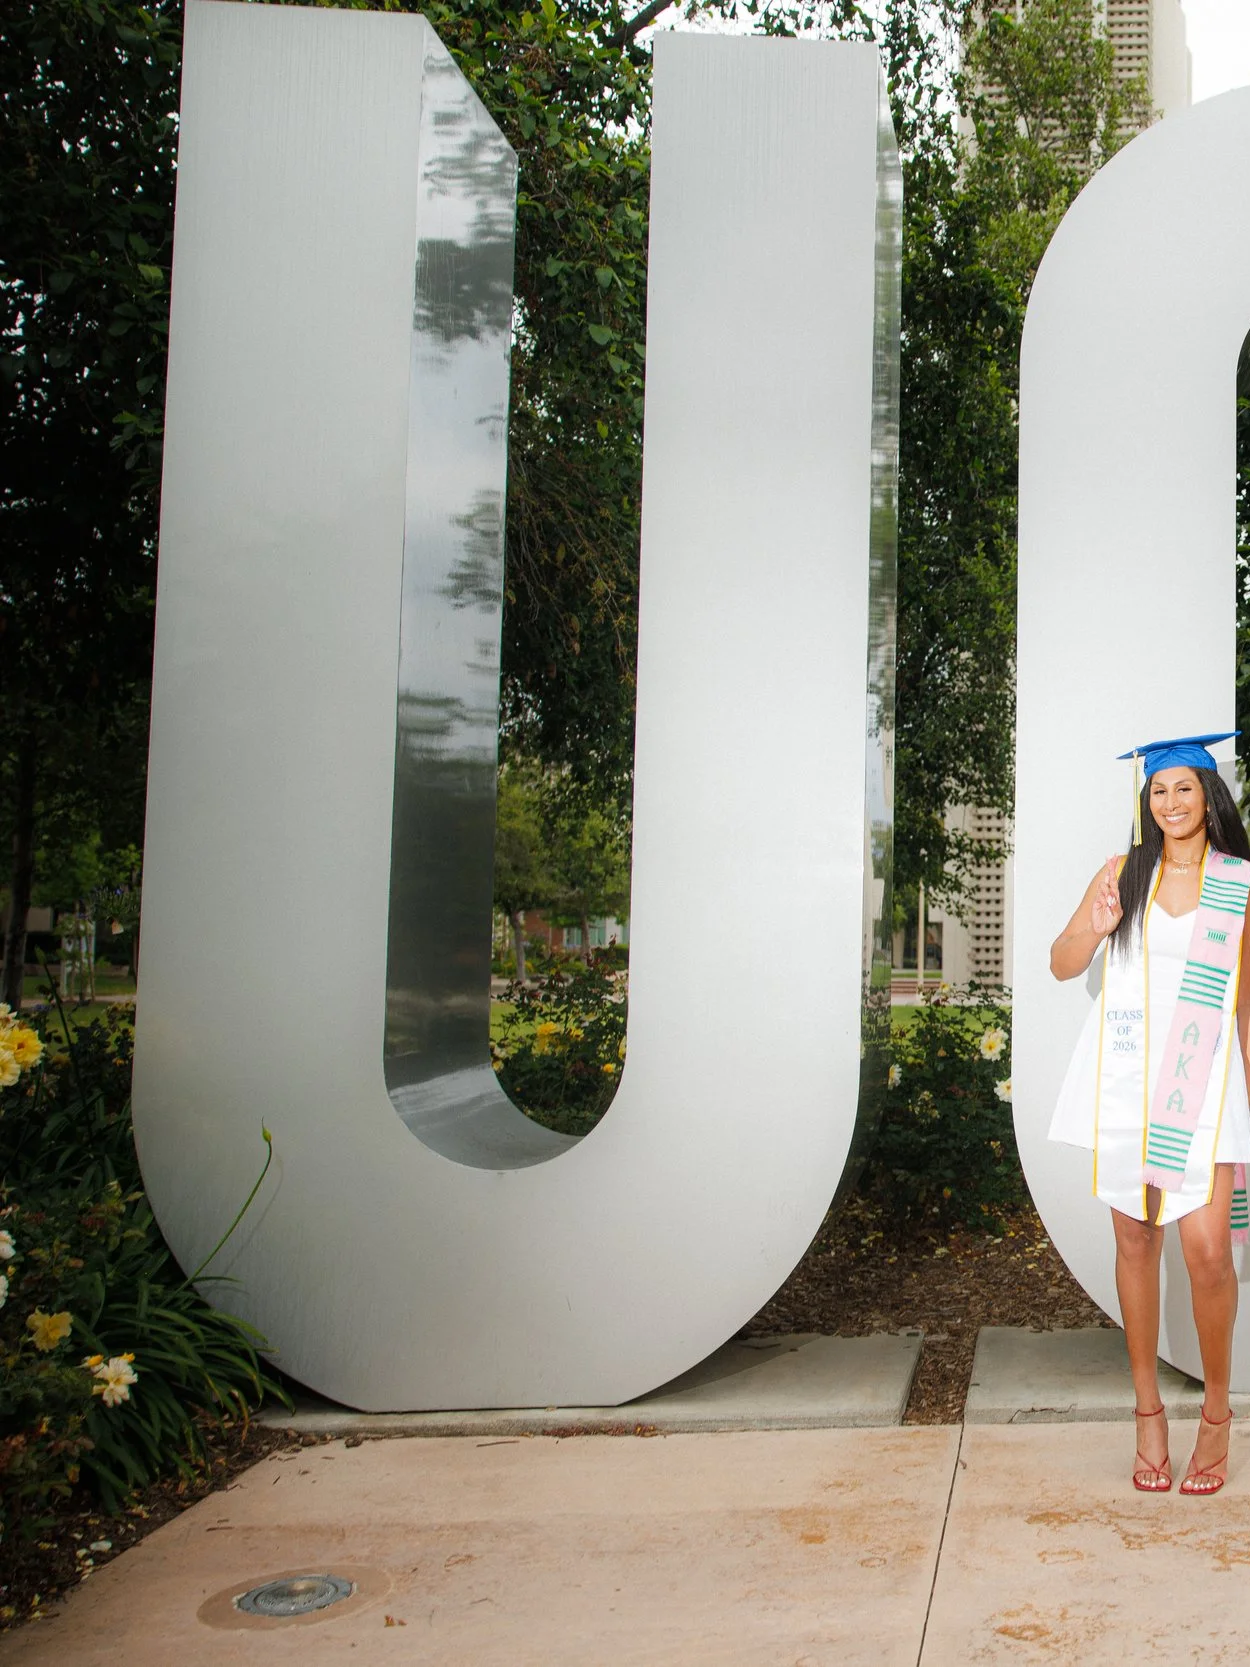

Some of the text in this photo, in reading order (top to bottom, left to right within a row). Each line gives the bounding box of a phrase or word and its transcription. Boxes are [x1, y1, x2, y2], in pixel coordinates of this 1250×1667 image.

[1106, 1009, 1143, 1021] CLASS
[1116, 1025, 1133, 1036] OF
[1112, 1040, 1137, 1051] 2026
[1166, 1020, 1200, 1114] AKA
